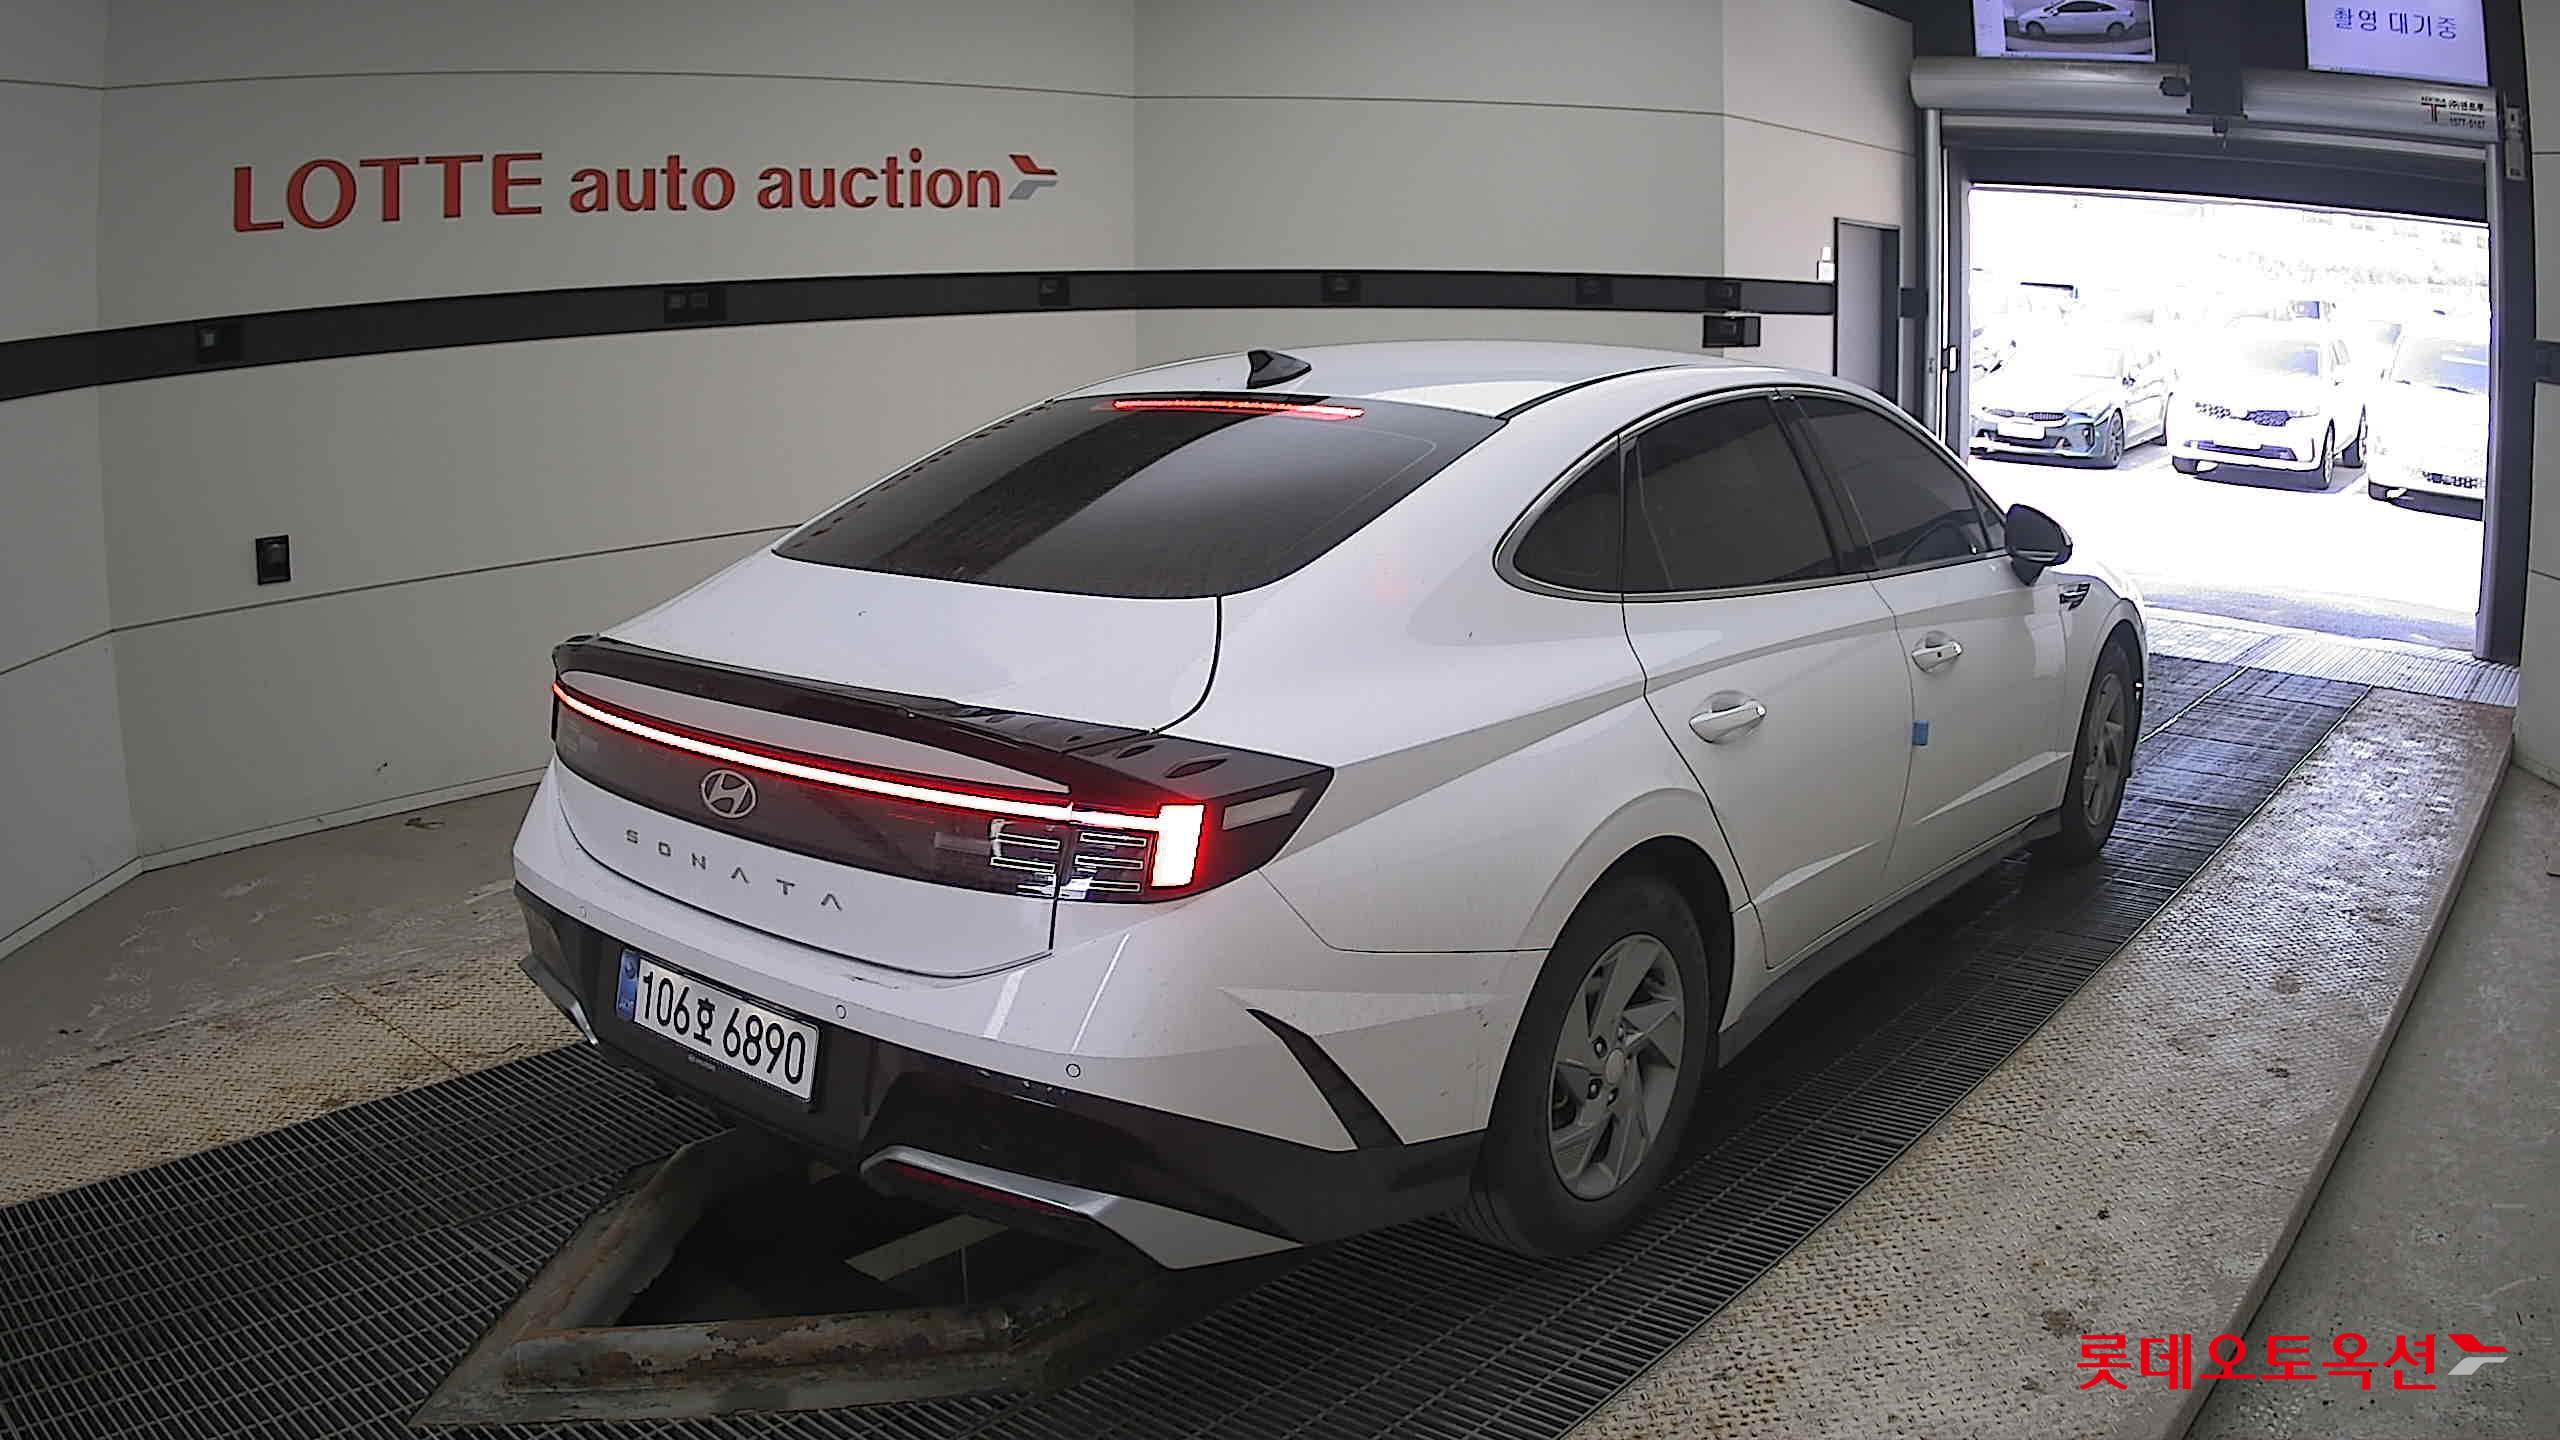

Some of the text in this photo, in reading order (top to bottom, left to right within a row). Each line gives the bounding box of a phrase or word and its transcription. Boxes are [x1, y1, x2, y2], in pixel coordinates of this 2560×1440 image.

[2334, 7, 2457, 40] 촬영 대기중
[234, 147, 1001, 232] LOTTE auto auction
[626, 829, 842, 911] SONATA
[643, 971, 806, 1084] 106호 6890
